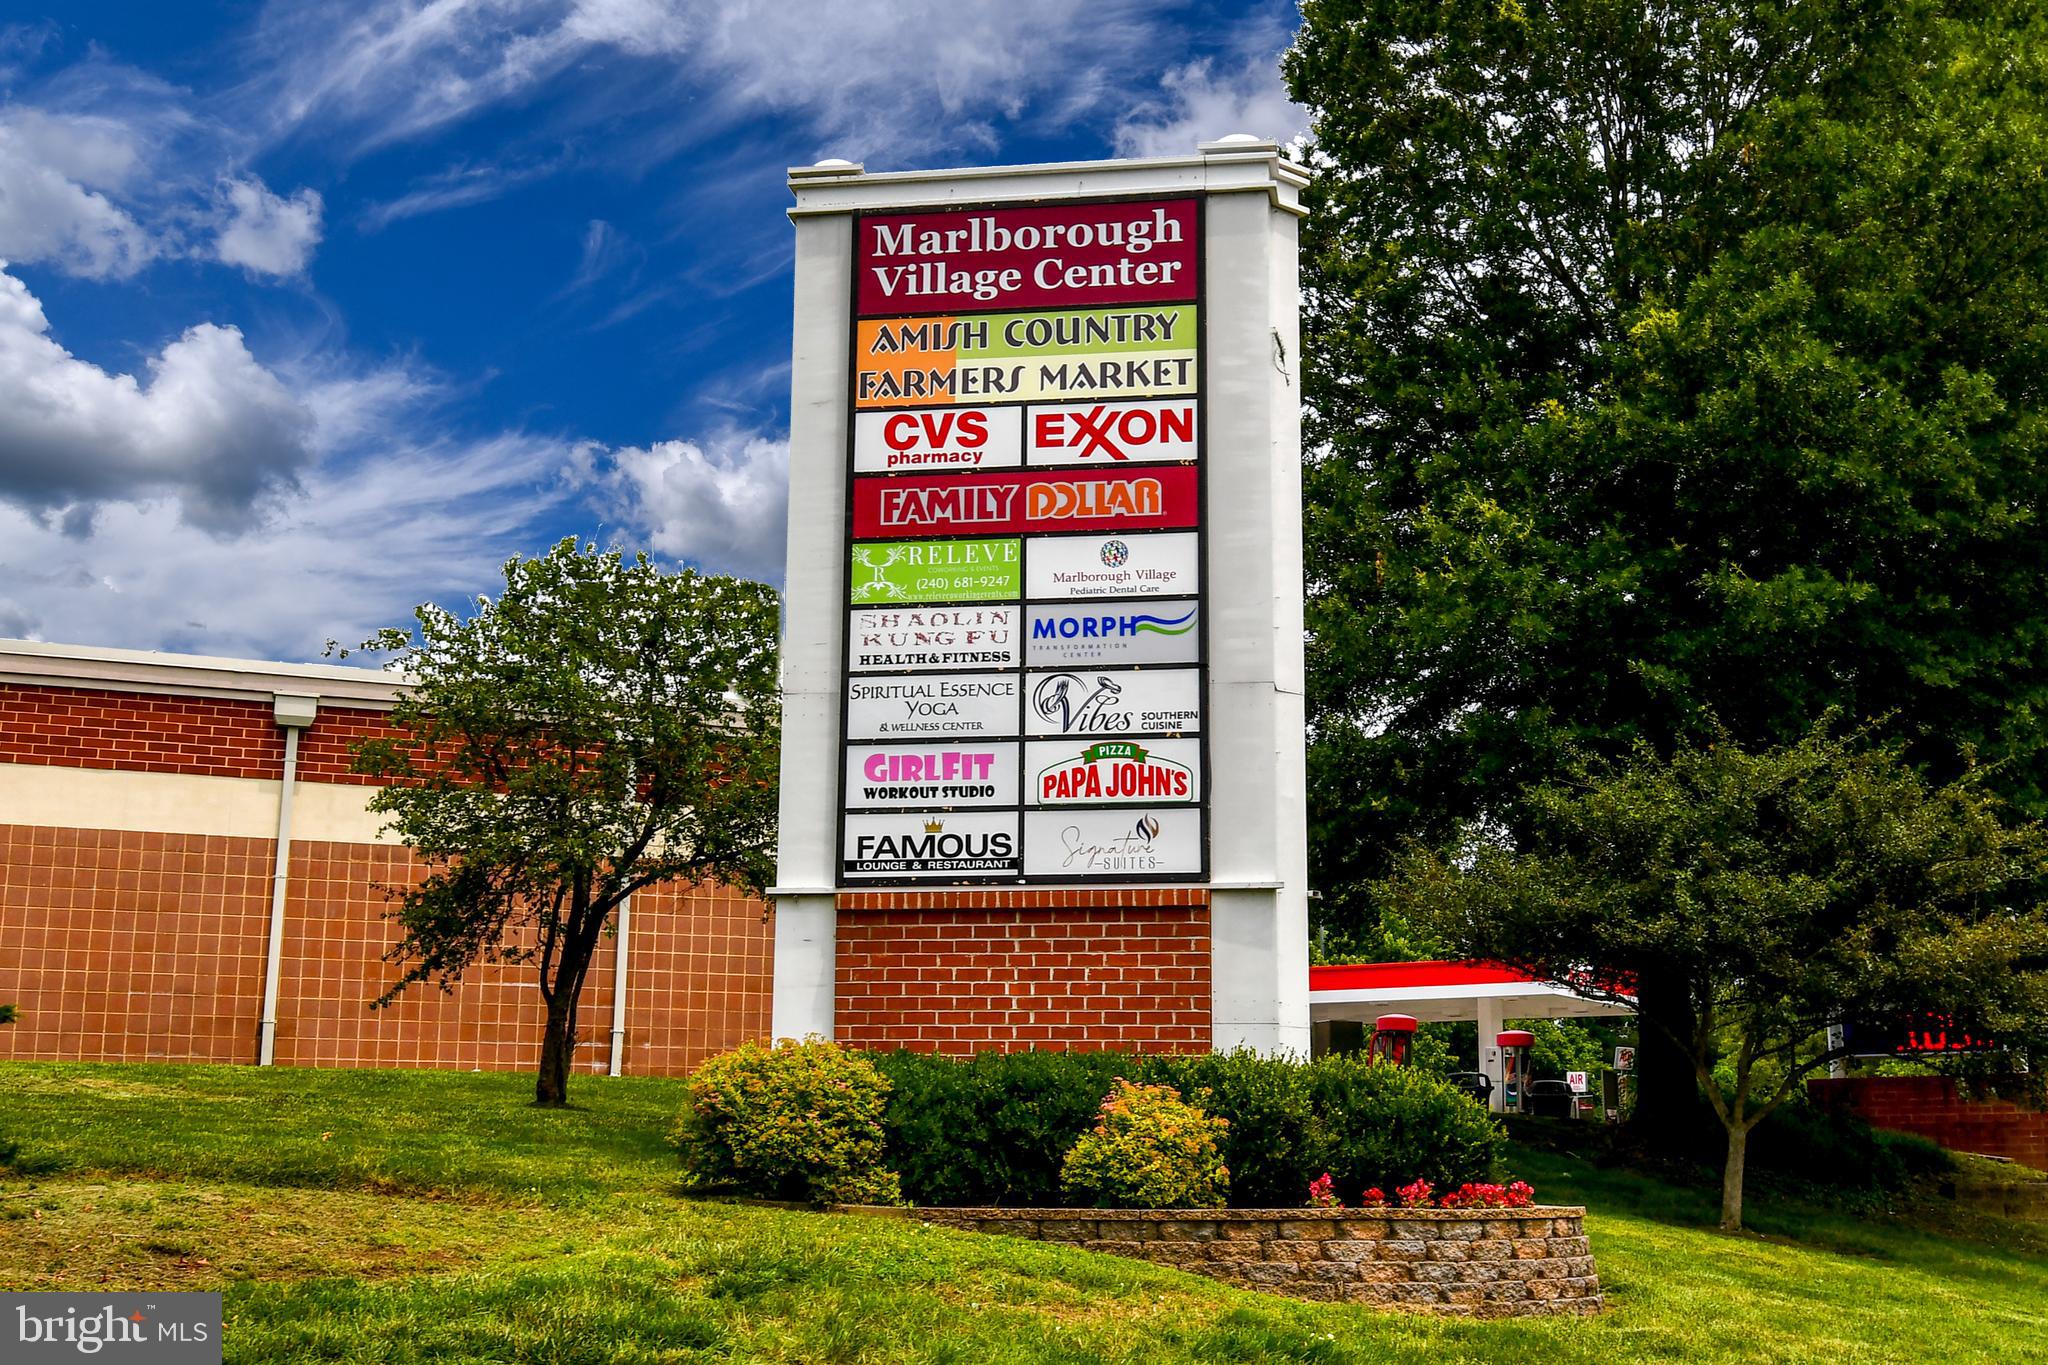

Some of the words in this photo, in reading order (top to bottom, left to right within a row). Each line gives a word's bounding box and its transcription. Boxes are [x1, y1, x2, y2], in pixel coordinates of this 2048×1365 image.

[872, 208, 1184, 257] Marlborough
[871, 262, 1022, 301] Village
[1033, 257, 1182, 290] Center
[870, 320, 989, 354] AMISH
[1004, 311, 1179, 348] COUNTRY
[858, 365, 1026, 400] FARMERS
[1040, 357, 1194, 392] MARKET
[883, 411, 989, 451] CVS
[1035, 405, 1194, 460] EXXON
[887, 451, 983, 468] pharmacy
[880, 483, 1020, 526] FAMILY
[1026, 478, 1163, 521] DOLLAR
[908, 539, 1018, 566] RELEVÉ
[916, 577, 949, 591] (240)
[953, 575, 1010, 589] 681-9247
[1053, 570, 1131, 584] Marlborough
[1135, 569, 1177, 583] Village
[1070, 586, 1107, 595] Pediatric
[1109, 585, 1137, 594] Dental
[1139, 585, 1160, 593] Care
[859, 610, 1012, 630] SHAOLIN
[1032, 615, 1137, 639] MORPH
[861, 631, 956, 647] KUNG
[966, 629, 1010, 644] FU
[1032, 643, 1128, 651] TRANSFORMATION
[904, 700, 960, 720] YOGA
[1040, 676, 1134, 734] Vibes
[1141, 711, 1198, 721] SOUTHERN
[1141, 721, 1183, 730] CUISINE
[879, 722, 889, 732] &
[891, 722, 940, 732] WELLNESS
[942, 721, 984, 731] CENTER
[1099, 745, 1131, 756] PIZZA
[863, 752, 995, 783] GIRLFIT
[1043, 764, 1102, 798] PAPA
[1105, 763, 1187, 797] JOHN'S
[863, 785, 939, 800] WORKOUT
[942, 785, 995, 798] STUDIO
[857, 833, 1013, 860] FAMOUS
[1061, 825, 1155, 869] Signature
[856, 861, 907, 871] LOUNGE
[912, 861, 922, 870] &
[927, 859, 1011, 870] RESTAURANT
[1569, 1073, 1583, 1085] AIR
